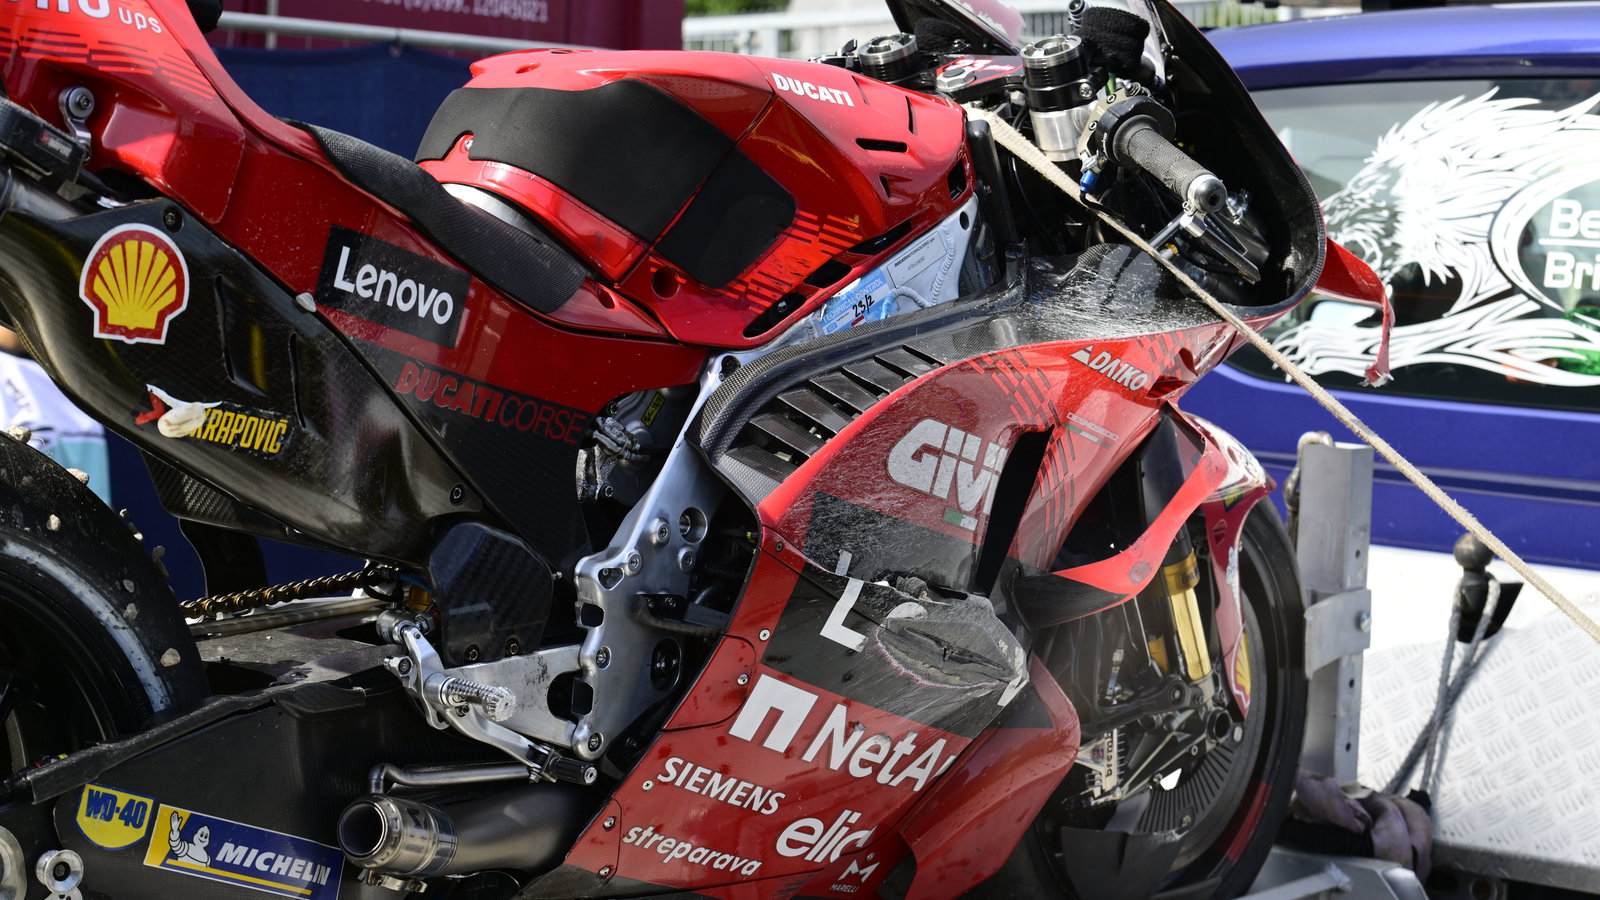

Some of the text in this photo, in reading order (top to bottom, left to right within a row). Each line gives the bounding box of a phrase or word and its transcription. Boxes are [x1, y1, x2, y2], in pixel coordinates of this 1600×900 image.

[118, 7, 162, 34] ups
[771, 72, 855, 107] DUCATI
[333, 245, 454, 325] Lenovo
[822, 277, 884, 323] TECHNICAL CONTROL
[1088, 350, 1149, 391] DAIKO
[887, 418, 1008, 515] GIVI
[802, 703, 958, 791] NetA
[86, 788, 148, 829] WD-40
[657, 757, 786, 815] SIEMENS
[215, 842, 331, 886] MICHELIN
[622, 826, 762, 876] streparava
